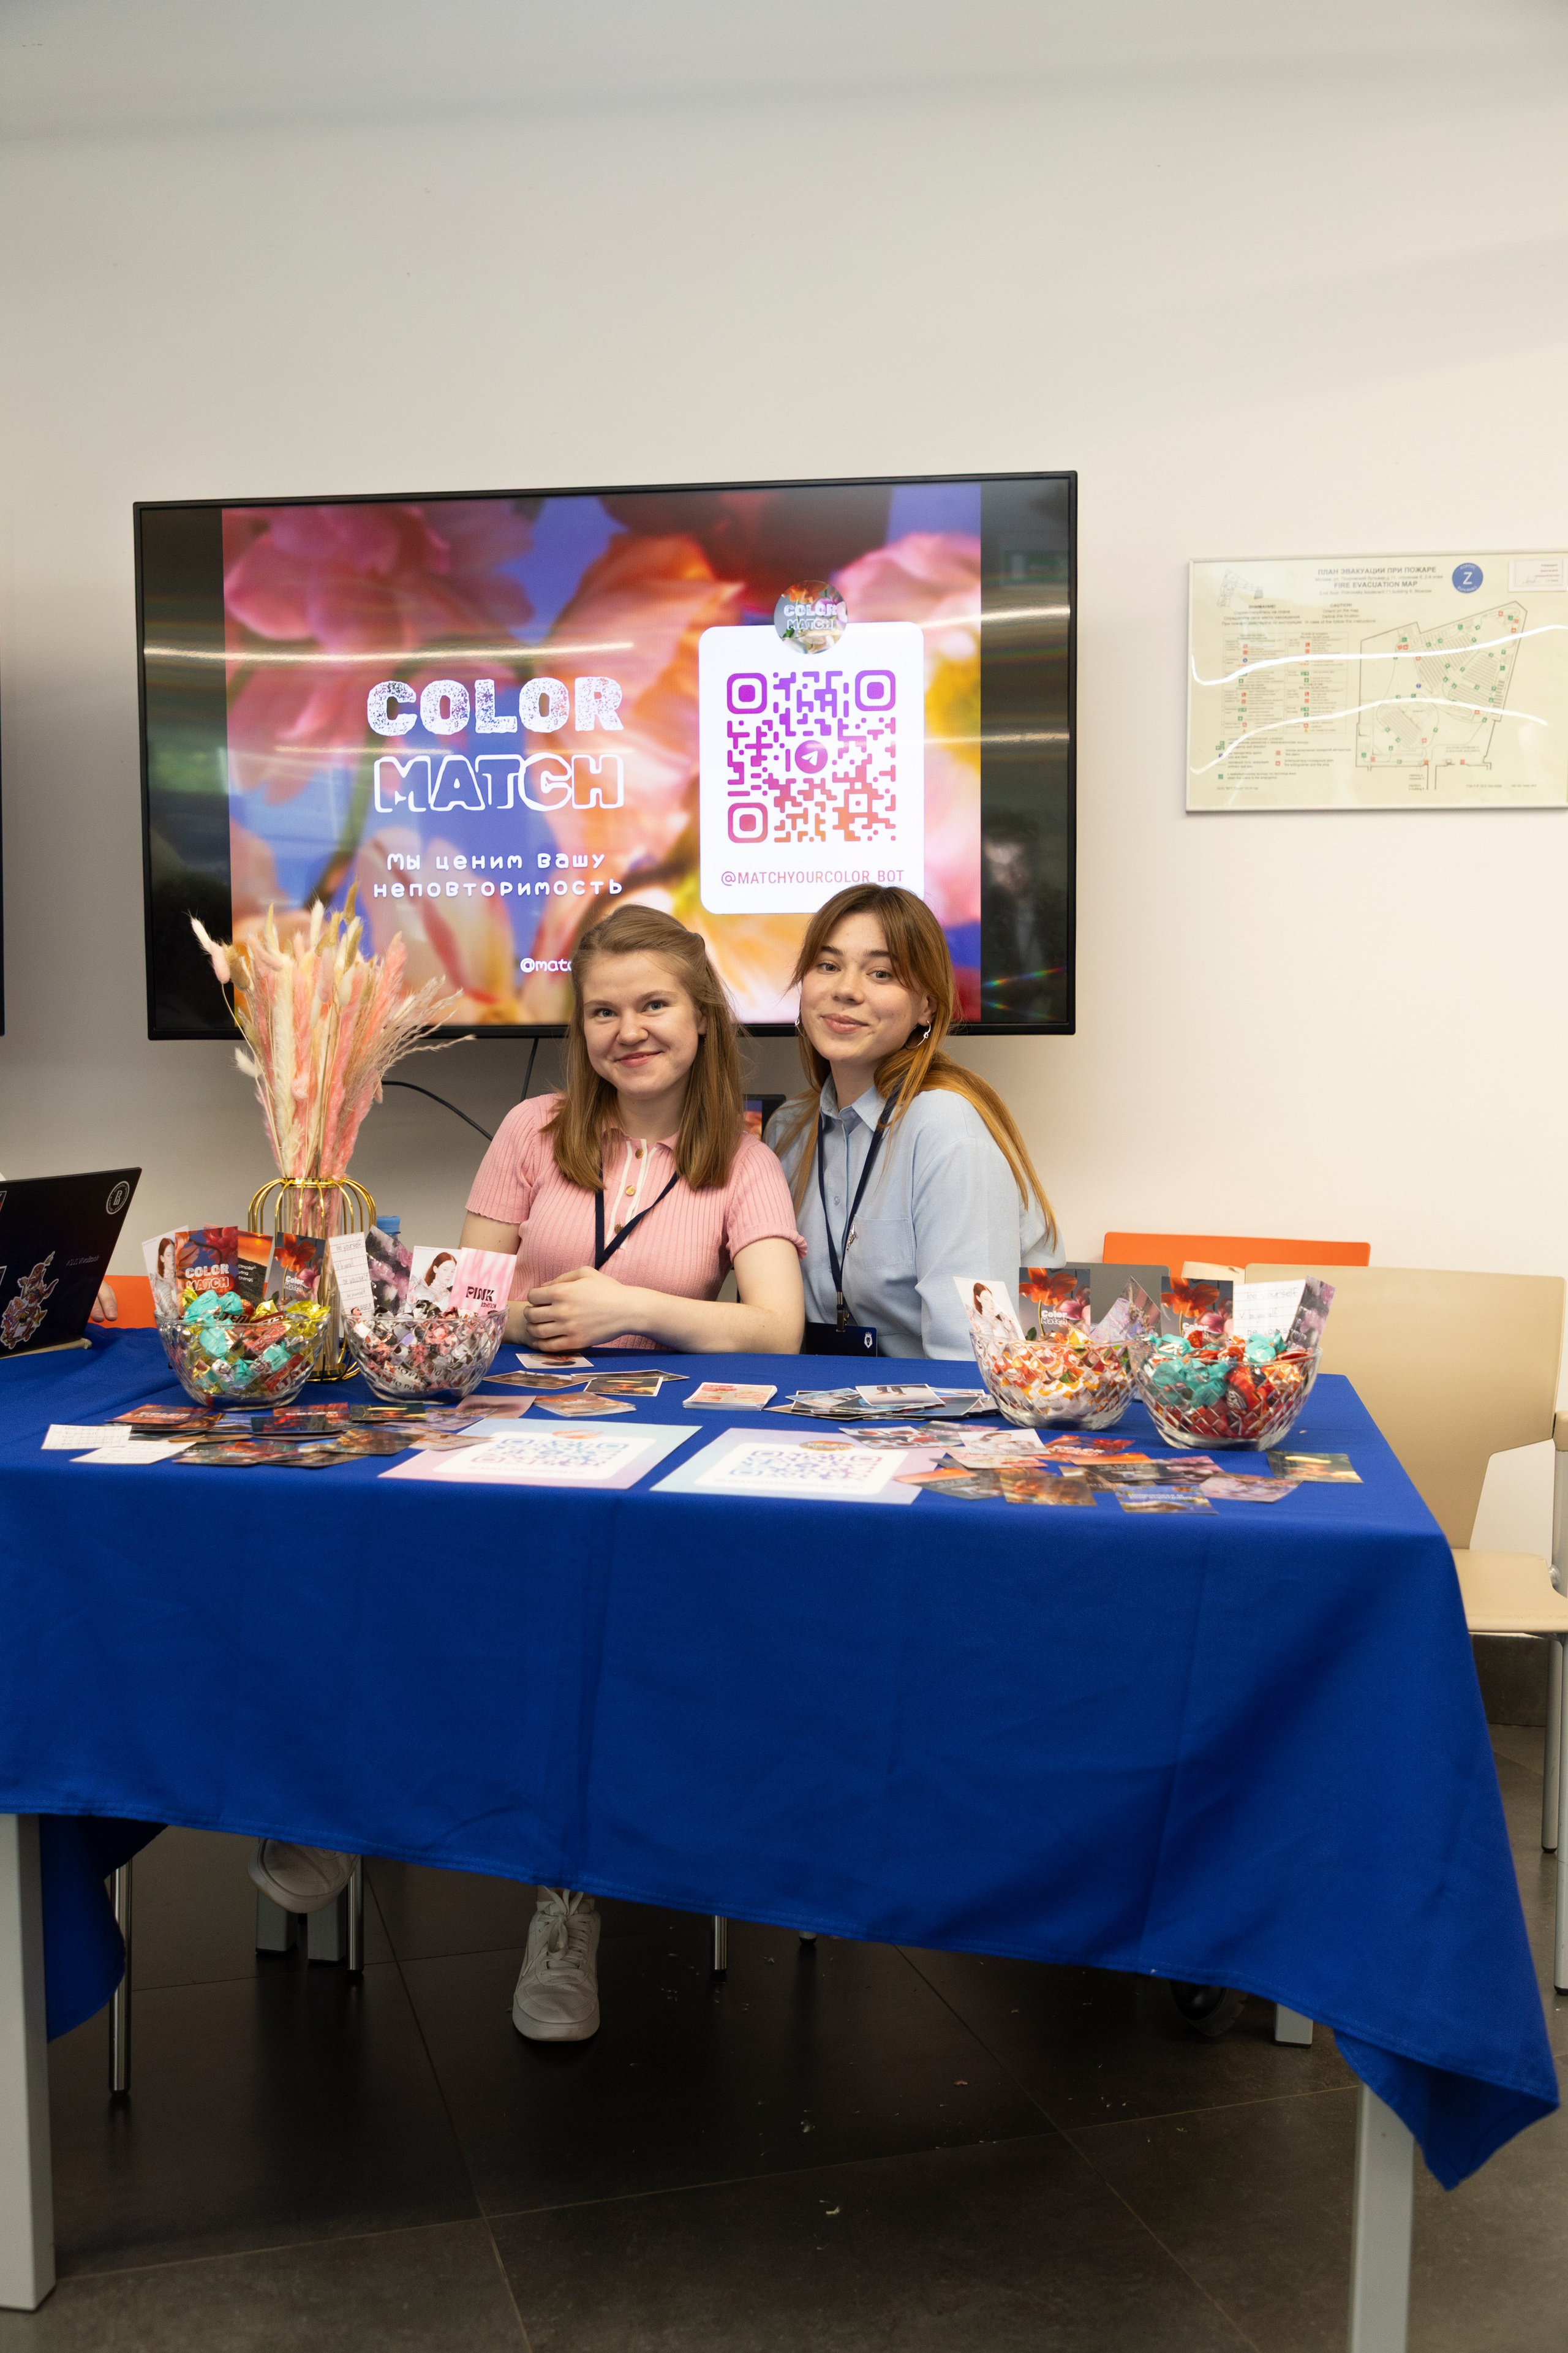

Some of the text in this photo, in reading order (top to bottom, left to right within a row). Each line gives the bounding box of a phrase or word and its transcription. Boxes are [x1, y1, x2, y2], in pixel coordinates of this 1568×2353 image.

[1463, 572, 1473, 585] Z
[783, 603, 837, 616] COLOR
[786, 618, 834, 630] MATCH
[368, 677, 624, 736] COLOR
[374, 752, 624, 812] MATCH
[387, 853, 421, 871] Мы
[436, 854, 522, 871] ценим
[721, 870, 870, 886] @MATCHYOURCOLOR
[374, 878, 623, 898] неповторимость
[185, 1263, 230, 1278] COLOR
[186, 1276, 230, 1291] MATCH
[285, 1275, 304, 1285] Color
[466, 1286, 494, 1302] PINK
